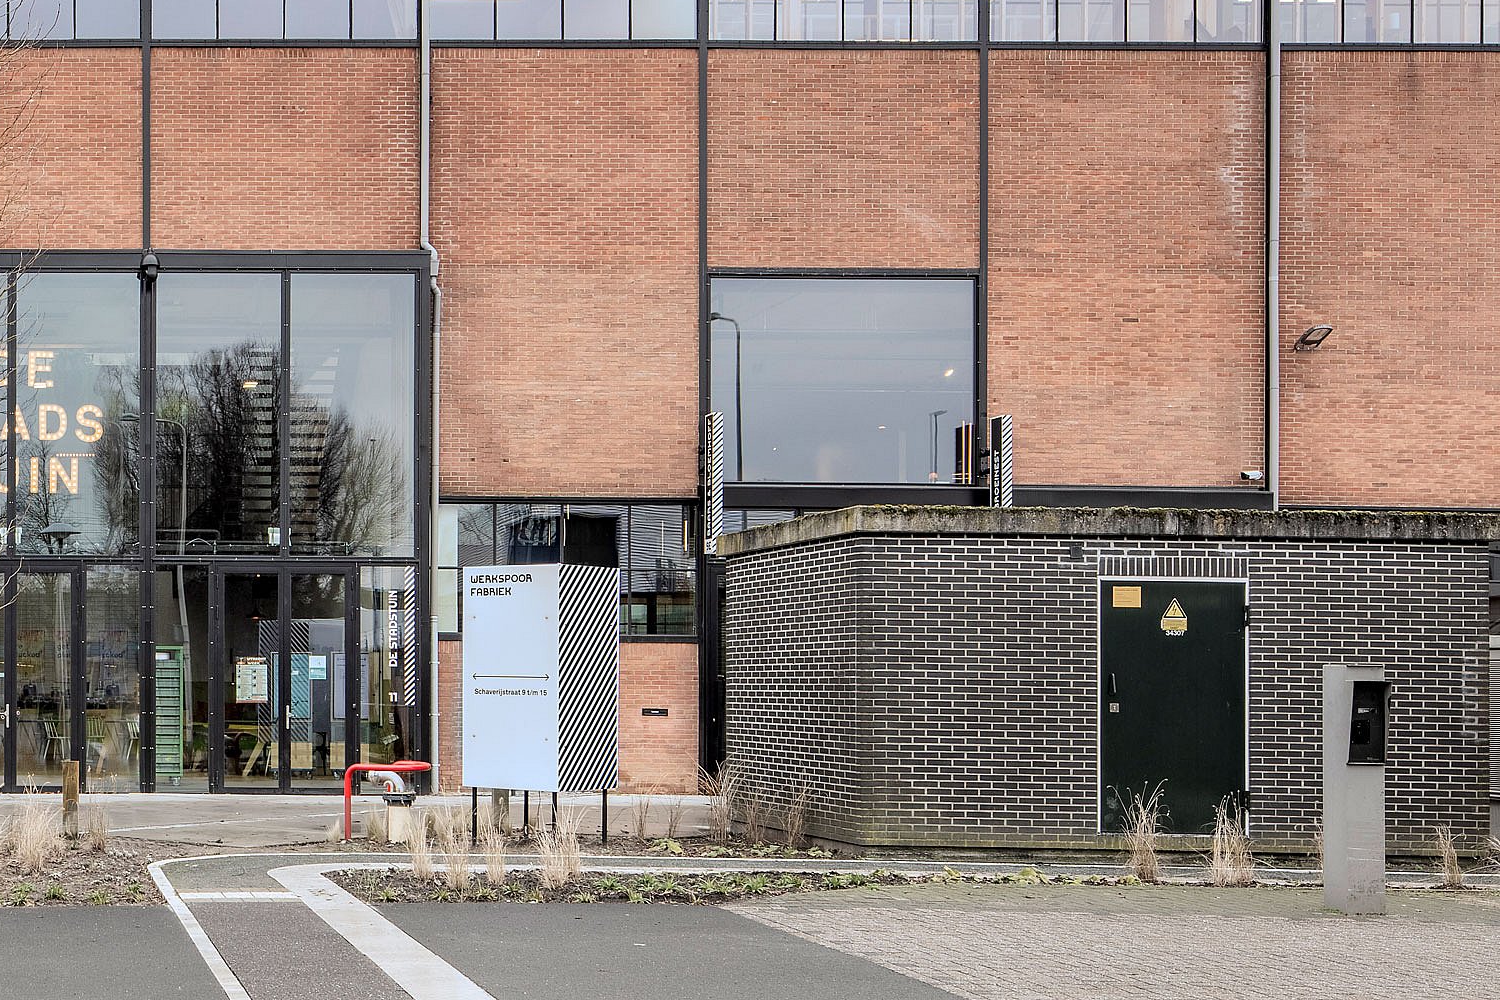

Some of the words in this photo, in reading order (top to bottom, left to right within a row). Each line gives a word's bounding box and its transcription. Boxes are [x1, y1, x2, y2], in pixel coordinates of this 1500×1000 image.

[470, 574, 533, 584] WERKSPOOR
[470, 587, 512, 597] FABRIEK
[388, 590, 398, 650] STADSTUIN
[388, 652, 398, 668] DE
[388, 692, 398, 702] 11
[474, 687, 521, 697] Schaverijstraat
